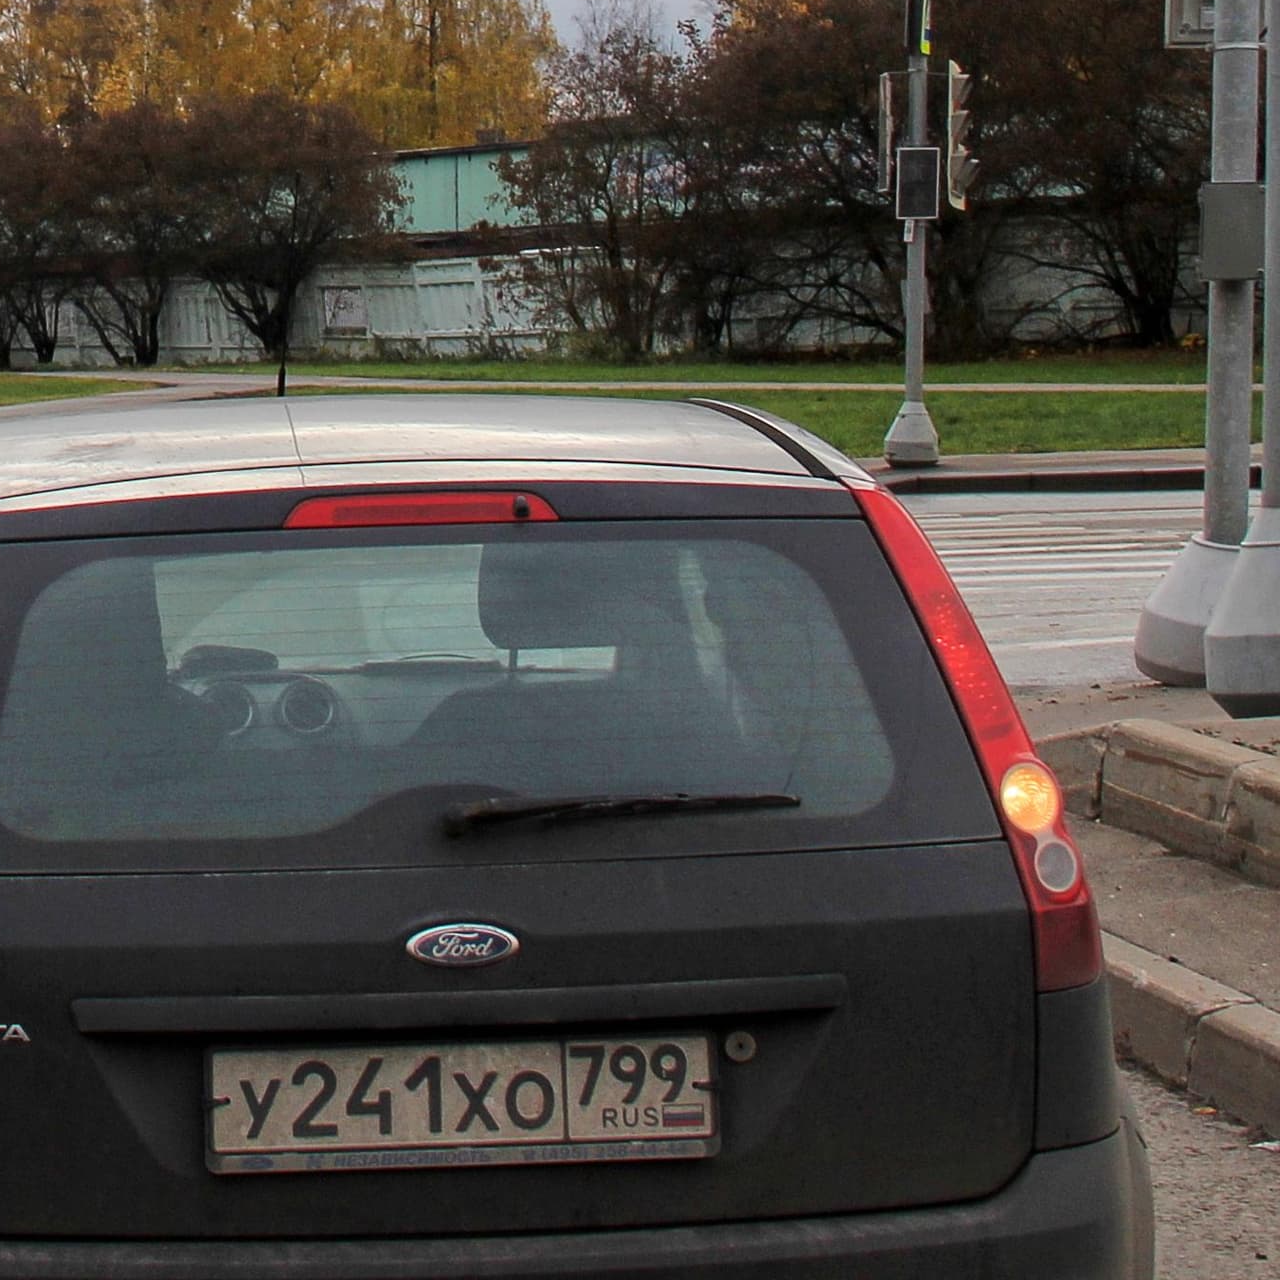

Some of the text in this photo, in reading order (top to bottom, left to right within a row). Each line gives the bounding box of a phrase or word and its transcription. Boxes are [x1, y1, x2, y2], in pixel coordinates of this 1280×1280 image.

[433, 931, 493, 957] Ford
[239, 1043, 689, 1139] У241ХО 799
[601, 1107, 660, 1129] RUS
[333, 1149, 491, 1167] НЕЗАВИСИМОСТЬ
